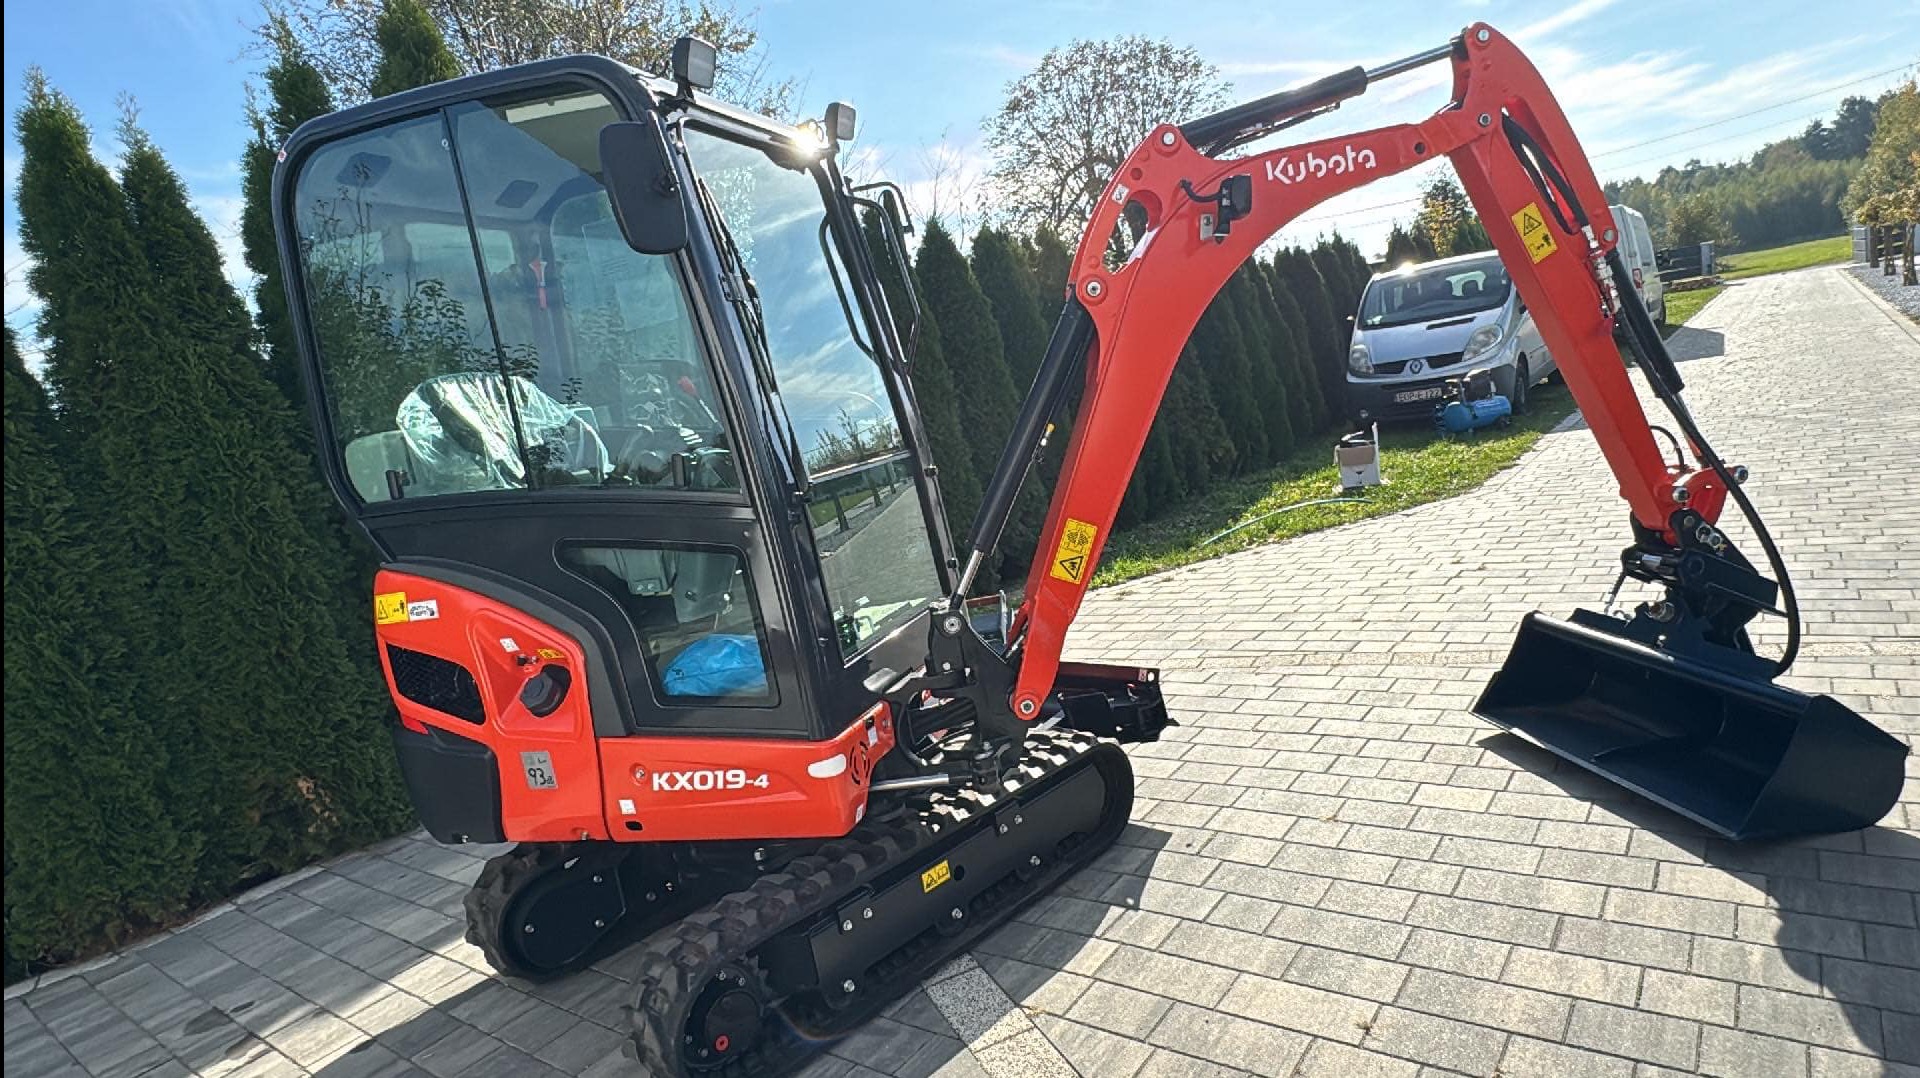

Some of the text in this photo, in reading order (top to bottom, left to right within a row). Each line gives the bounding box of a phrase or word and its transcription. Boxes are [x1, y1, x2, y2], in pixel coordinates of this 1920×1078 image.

[1265, 145, 1377, 184] Kubota
[528, 767, 546, 785] 93
[652, 769, 770, 791] KX019-4
